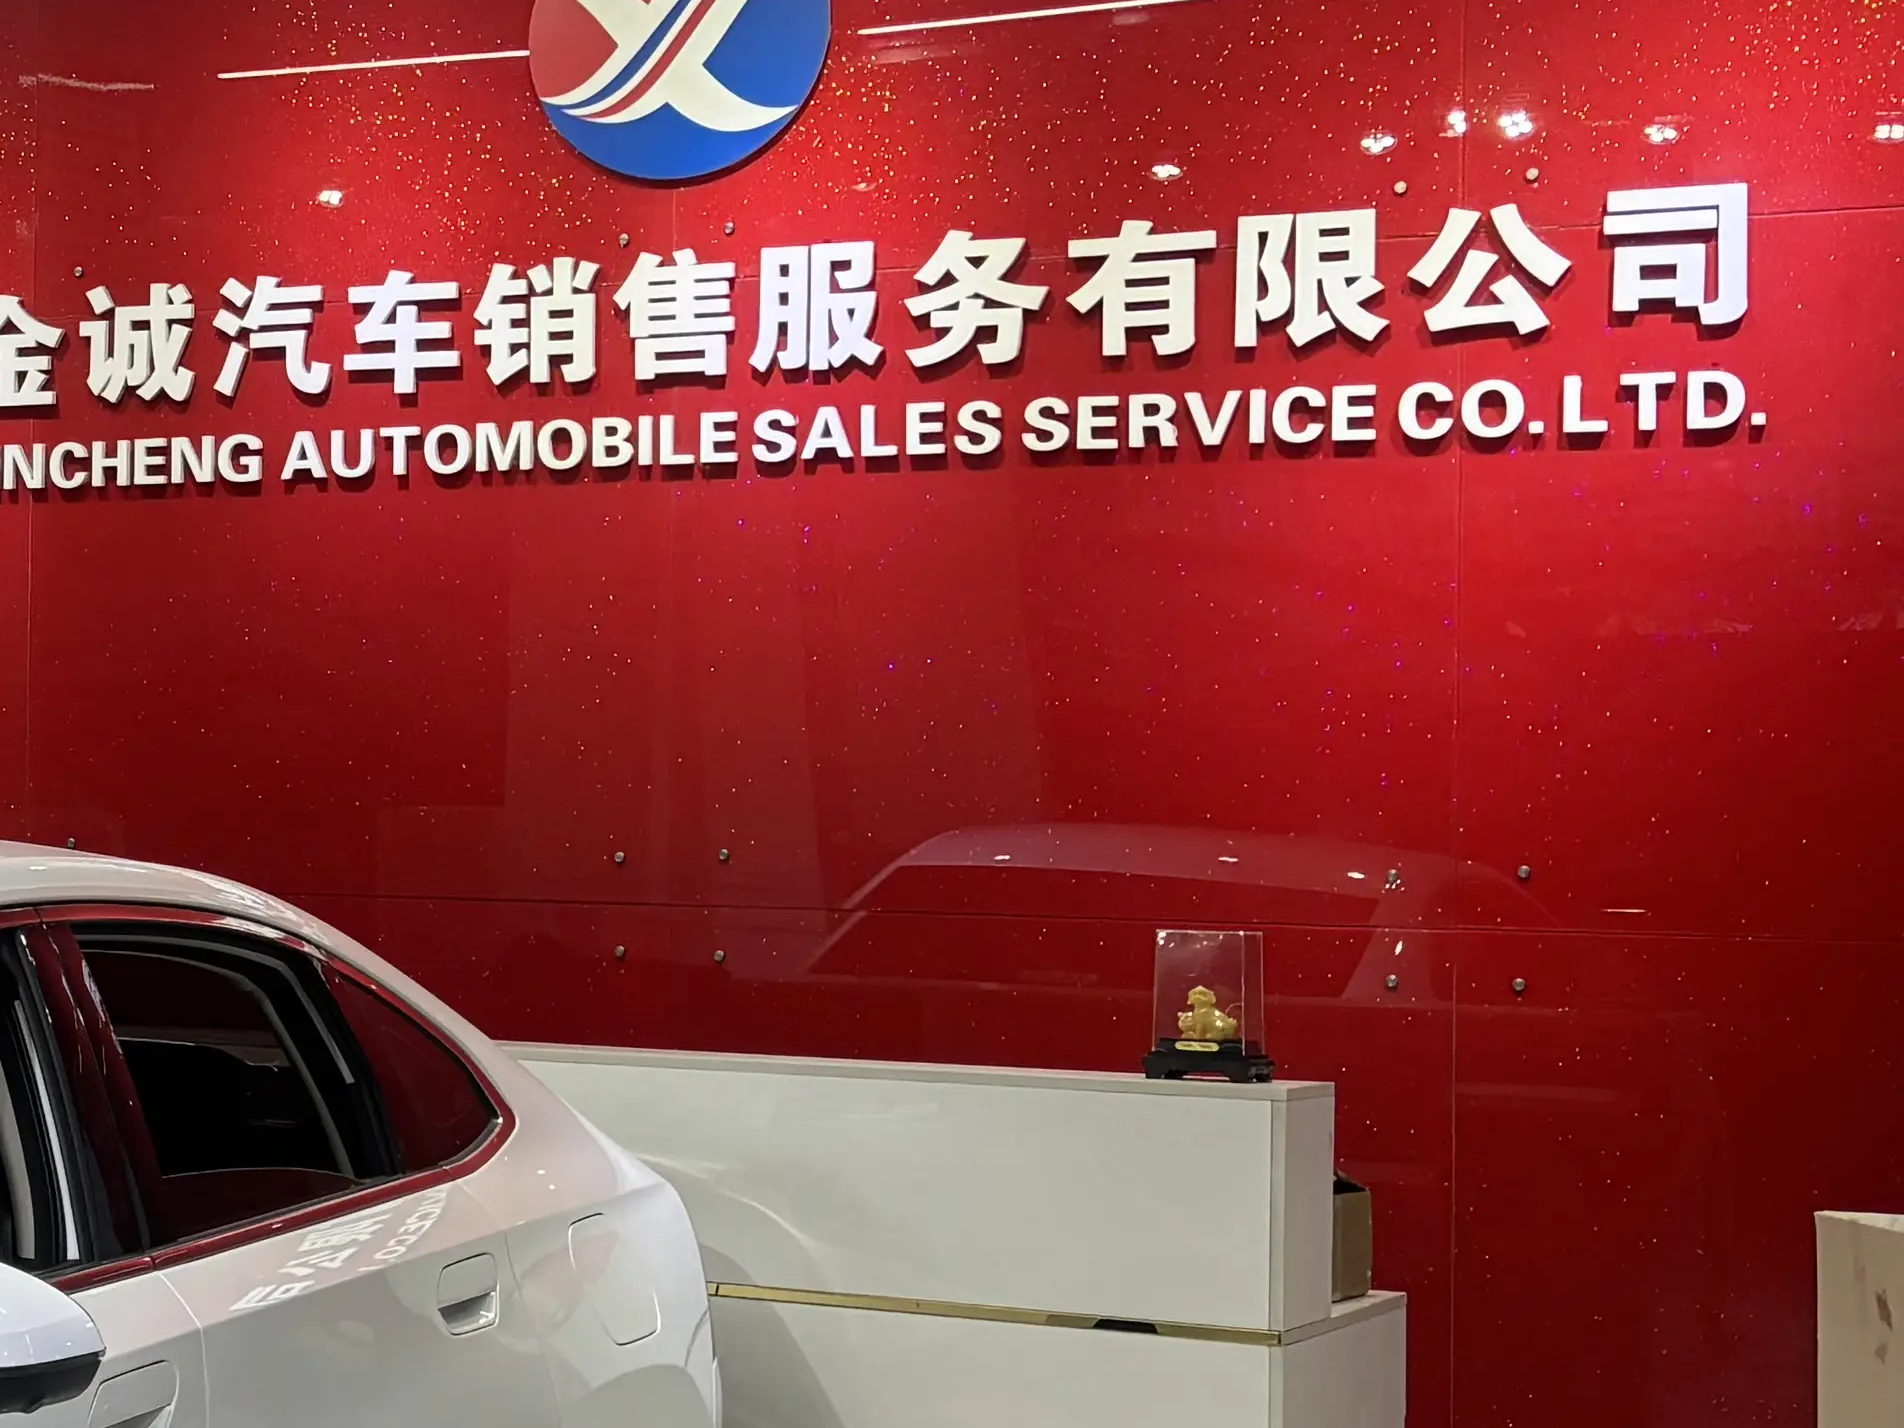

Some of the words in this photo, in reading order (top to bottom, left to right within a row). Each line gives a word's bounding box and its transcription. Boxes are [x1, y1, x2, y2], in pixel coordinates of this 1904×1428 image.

[280, 410, 740, 481] AUTOMOBILE
[751, 400, 1003, 463] SALES
[1021, 384, 1377, 452] SERVICE
